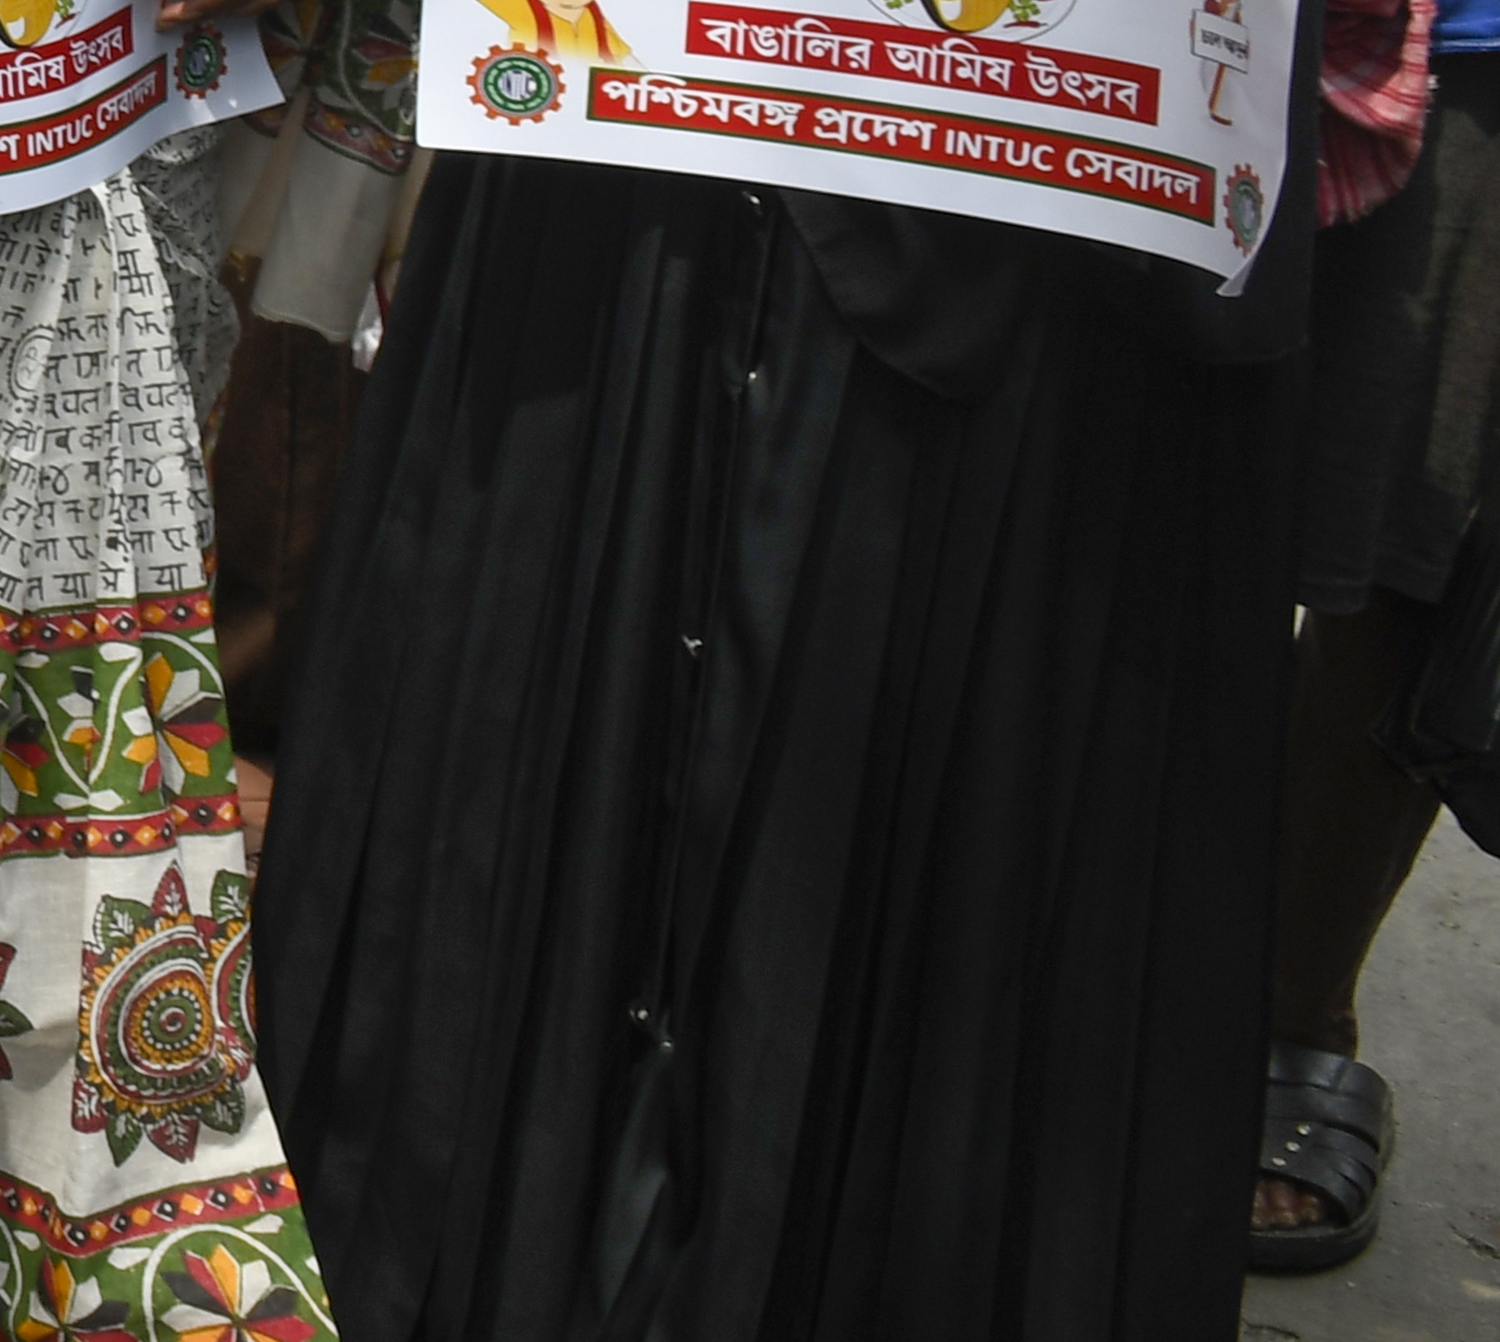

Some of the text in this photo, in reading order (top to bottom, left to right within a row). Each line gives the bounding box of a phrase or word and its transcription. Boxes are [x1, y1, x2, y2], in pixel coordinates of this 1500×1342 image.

[70, 25, 124, 74] উৎসব
[701, 17, 1140, 114] বাঙালির আমিষ উৎসব
[27, 114, 93, 157] INTUC
[96, 70, 157, 131] সেবাদল
[601, 74, 1201, 206] পশ্চিমবঙ্গ প্রদেশ INTUC সেবাদল
